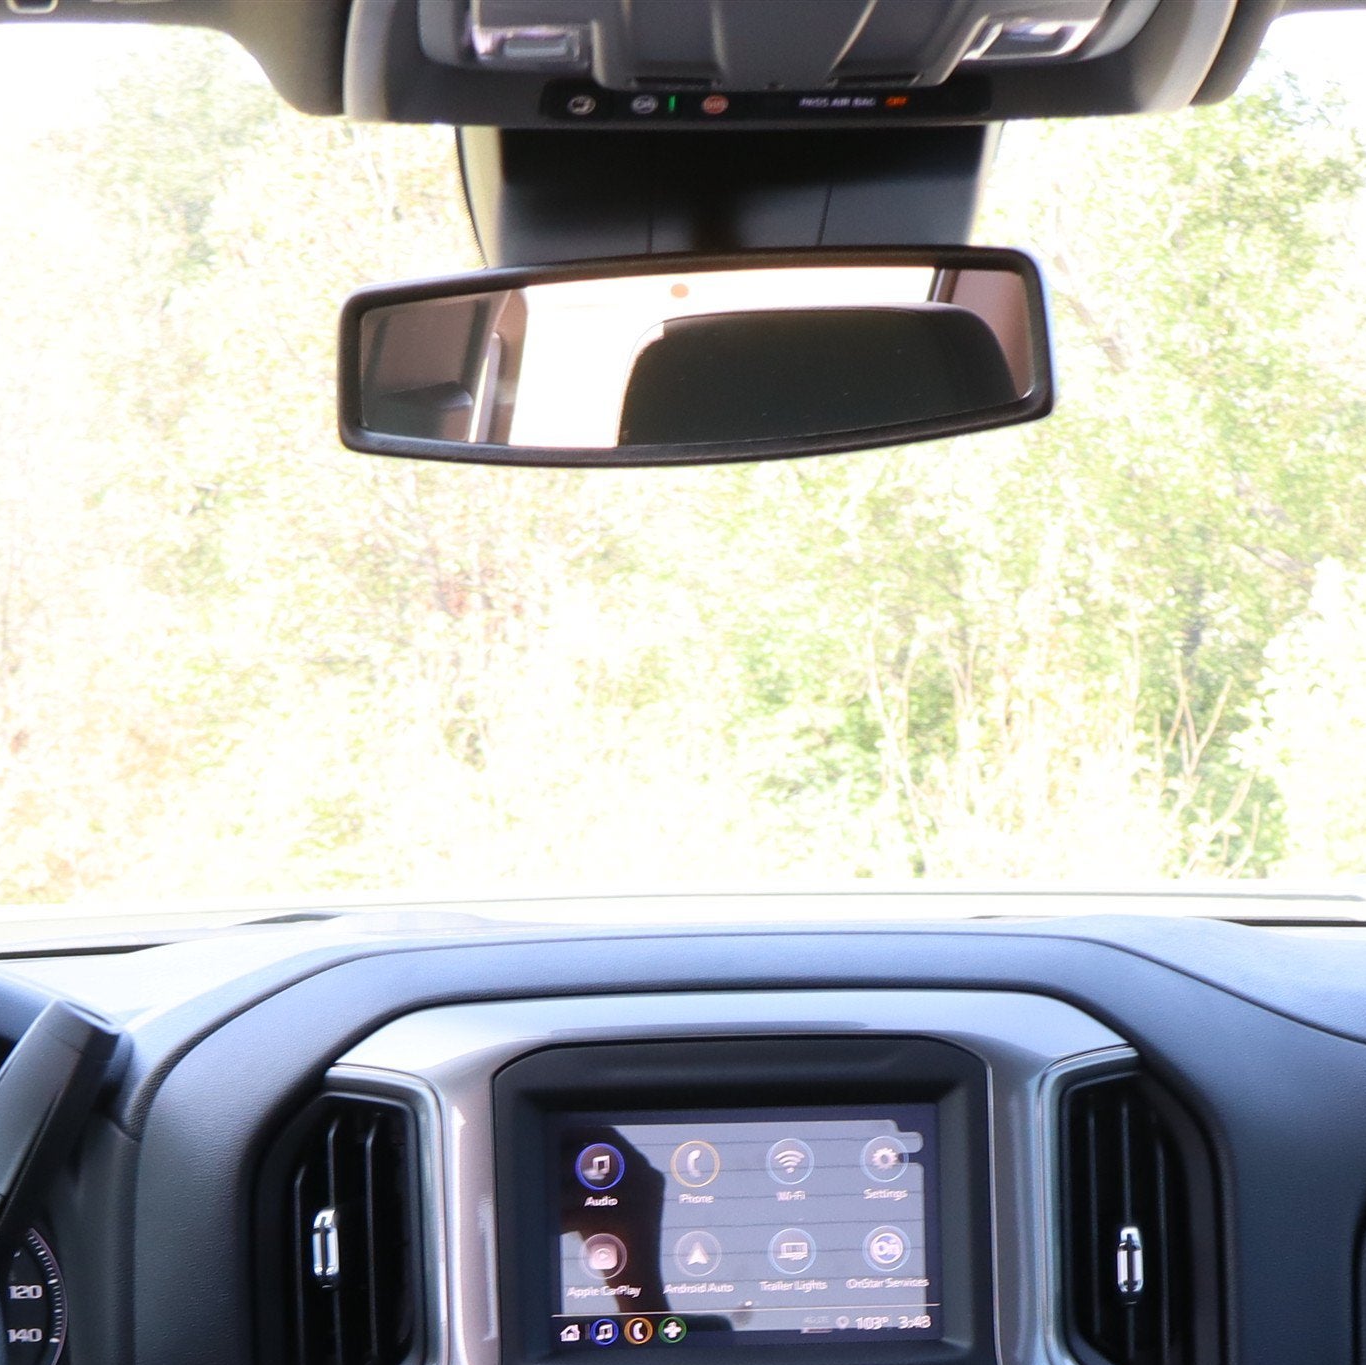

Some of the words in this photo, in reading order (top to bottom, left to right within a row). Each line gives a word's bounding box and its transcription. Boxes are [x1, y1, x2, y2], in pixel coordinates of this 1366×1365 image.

[678, 1193, 715, 1205] Phone
[776, 1190, 806, 1201] Wi-Fi
[862, 1188, 909, 1201] Settings
[583, 1195, 619, 1208] Audio
[662, 1282, 705, 1295] Android
[705, 1282, 735, 1294] Auto
[759, 1280, 793, 1292] Trailer
[794, 1279, 828, 1293] Lights
[845, 1277, 884, 1290] OnStar
[884, 1276, 930, 1289] Services
[8, 1284, 44, 1300] 120
[566, 1285, 599, 1299] Apple
[599, 1283, 642, 1299] CarPlay
[7, 1327, 43, 1343] 140
